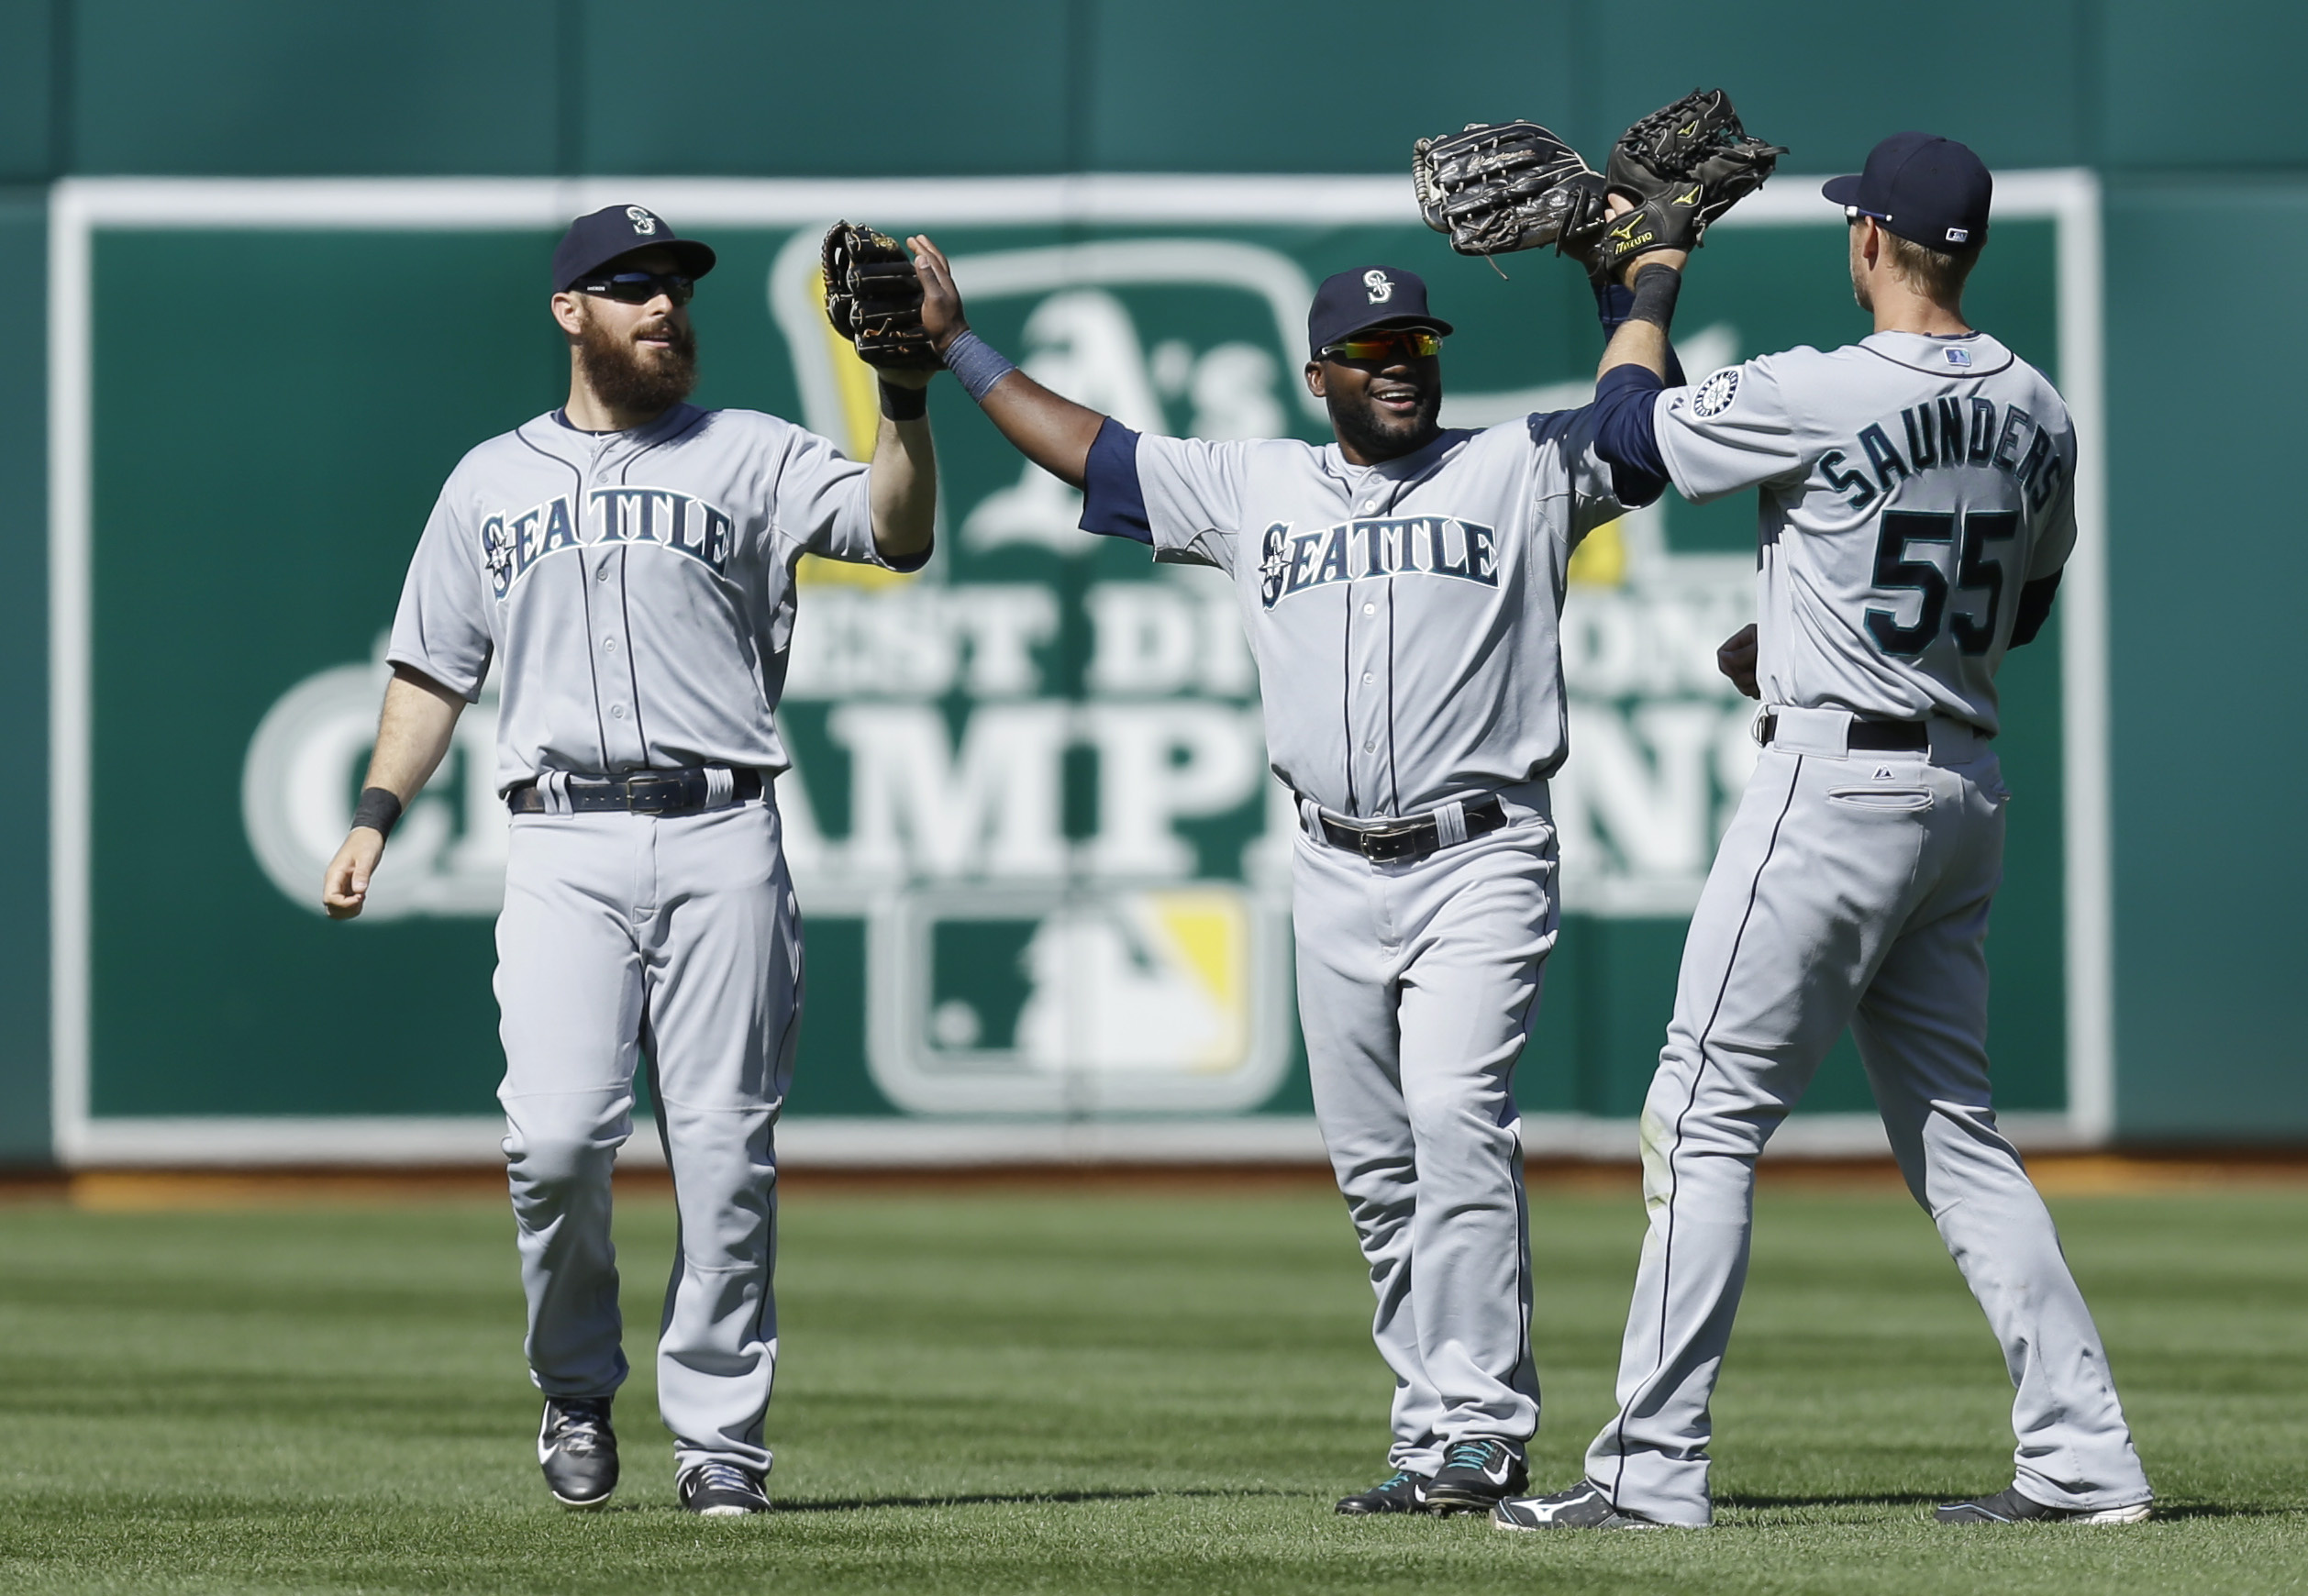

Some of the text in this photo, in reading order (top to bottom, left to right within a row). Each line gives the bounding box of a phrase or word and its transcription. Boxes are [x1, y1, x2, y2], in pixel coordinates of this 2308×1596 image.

[1818, 396, 2062, 515] SAUNDERS
[479, 485, 737, 603] SEATTLE
[1258, 513, 1502, 612] SEATTLE
[1863, 509, 2019, 657] 55
